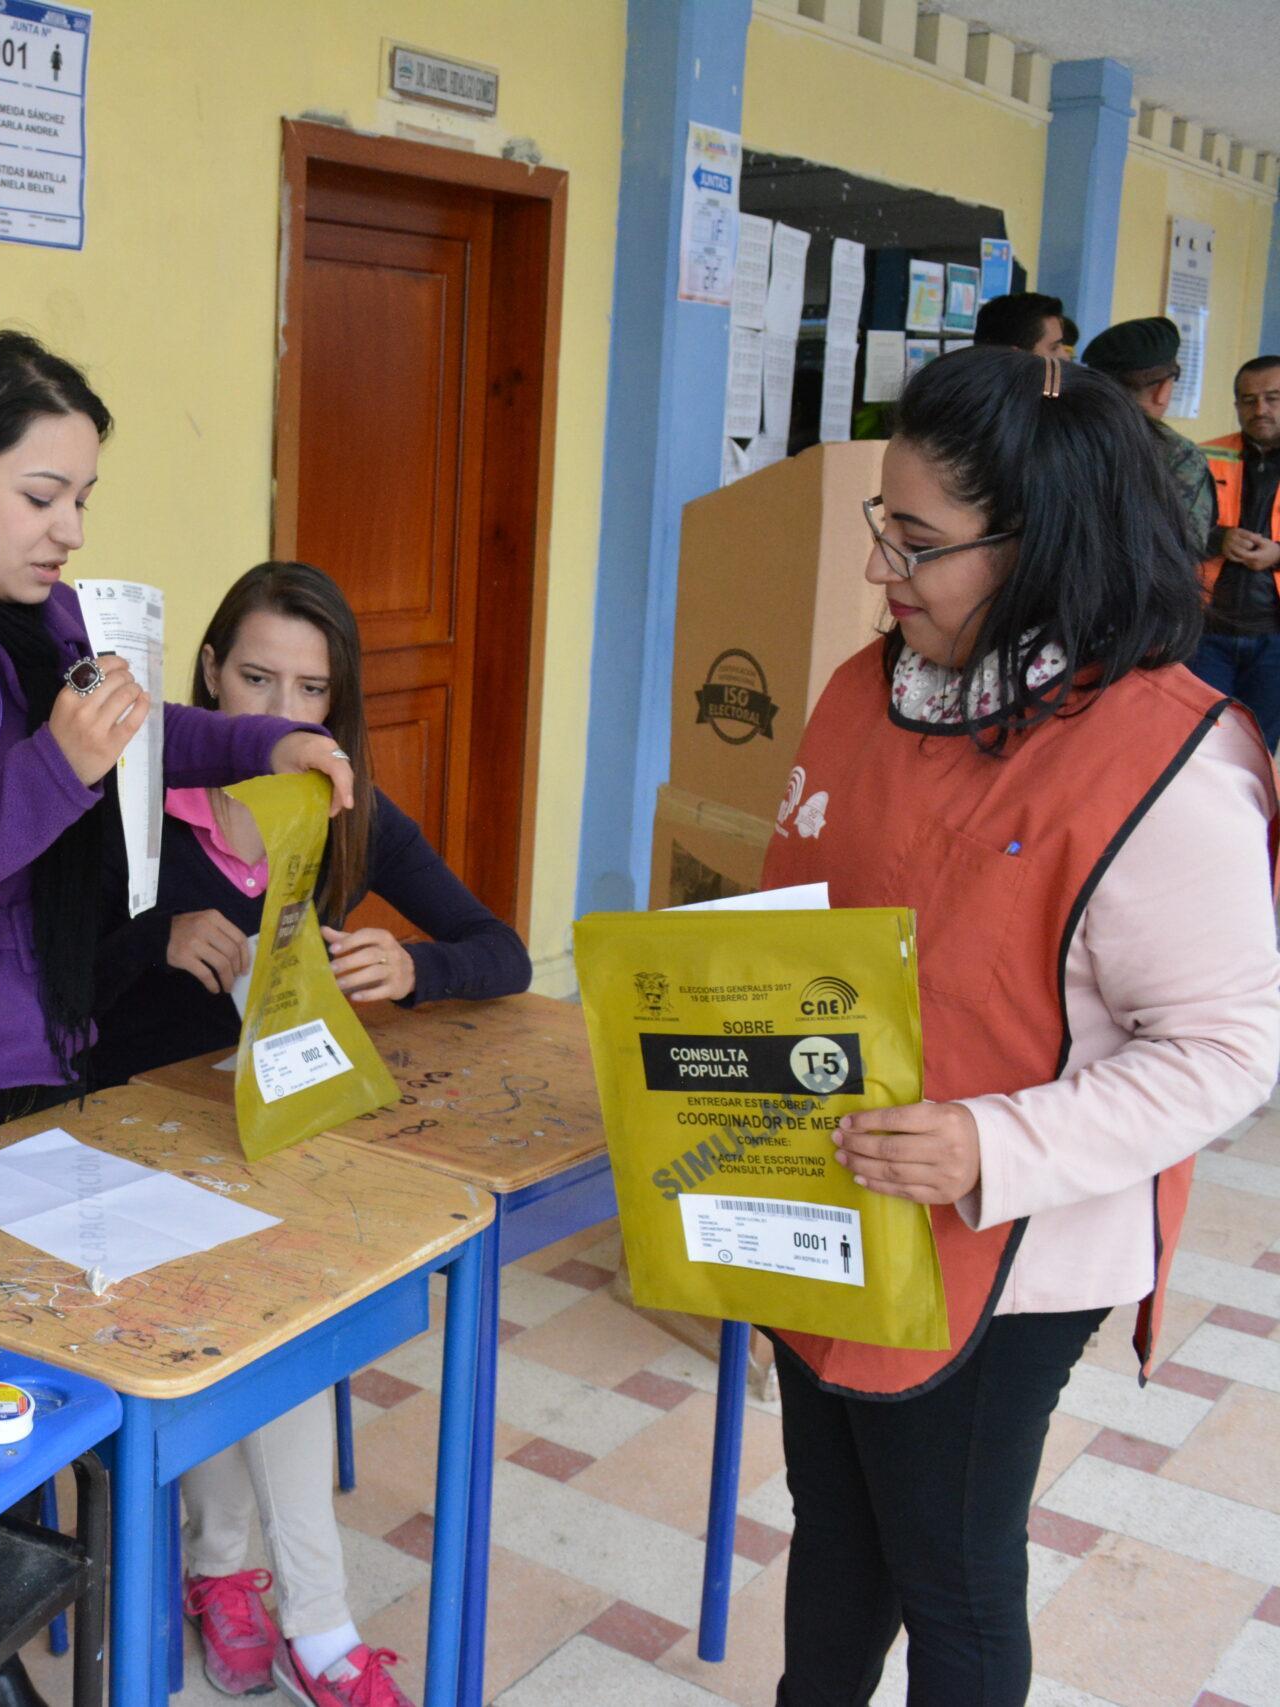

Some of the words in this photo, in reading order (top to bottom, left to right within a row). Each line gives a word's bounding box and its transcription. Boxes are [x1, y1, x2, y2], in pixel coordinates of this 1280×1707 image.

[10, 19, 40, 35] JUNTA
[25, 123, 59, 138] ANDREA
[26, 169, 67, 184] MANTILLA
[701, 174, 729, 189] JUNTAS
[724, 686, 749, 707] ISO
[709, 703, 761, 724] ELECTORAL
[679, 985, 725, 995] ELECCIONES
[726, 984, 774, 994] GENERALES
[775, 983, 792, 992] 2017
[711, 994, 748, 1002] FEBRERO
[752, 992, 769, 1001] 2017
[723, 1020, 775, 1035] SOBRE
[301, 1046, 322, 1063] 0002
[670, 1047, 749, 1063] CONSULTA
[799, 1051, 841, 1075] T5
[678, 1063, 749, 1078] POPULAR
[687, 1096, 742, 1108] ENTREGAR
[744, 1098, 771, 1108] ESTE
[773, 1100, 808, 1111] SOBRE
[811, 1101, 824, 1111] AL
[677, 1112, 783, 1130] COORDINADOR
[787, 1117, 807, 1130] DE
[811, 1117, 841, 1131] MES
[737, 1135, 792, 1147] CONTIENE:
[718, 1154, 744, 1164] ACTA
[747, 1155, 760, 1165] DE
[763, 1155, 826, 1166] ESCRUTINIO
[719, 1165, 773, 1176] CONSULTA
[776, 1166, 825, 1177] POPULAR
[793, 1231, 827, 1251] 0001
